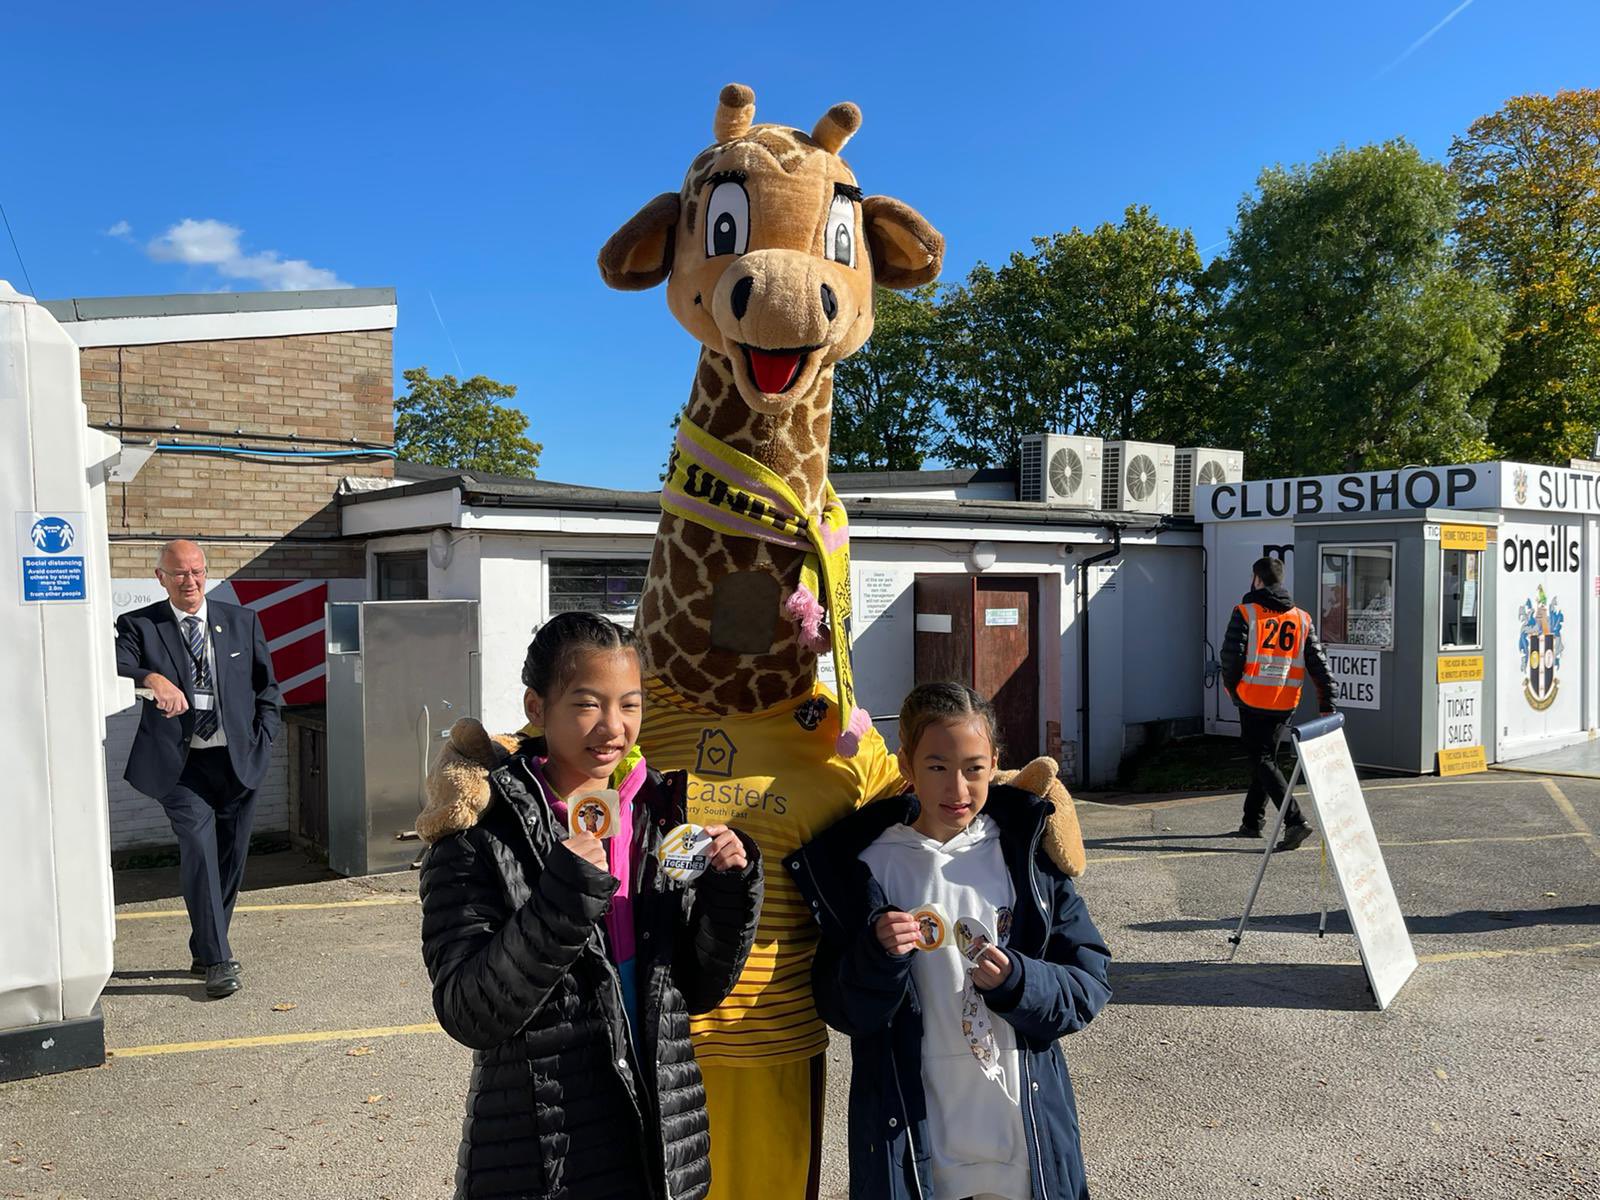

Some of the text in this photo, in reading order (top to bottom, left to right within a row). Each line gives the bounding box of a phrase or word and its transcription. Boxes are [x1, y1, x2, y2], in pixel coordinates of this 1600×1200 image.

[1211, 468, 1477, 519] CLUB SHOP
[1428, 526, 1439, 537] TIC
[133, 594, 151, 603] 2016
[1262, 619, 1296, 652] 26
[1329, 655, 1377, 677] TICKET
[1334, 682, 1374, 702] SALES
[1447, 698, 1474, 718] TICKET
[1448, 724, 1473, 744] SALES
[687, 781, 787, 815] casters
[685, 806, 748, 819] rty South East
[665, 859, 704, 870] TOGETHER
